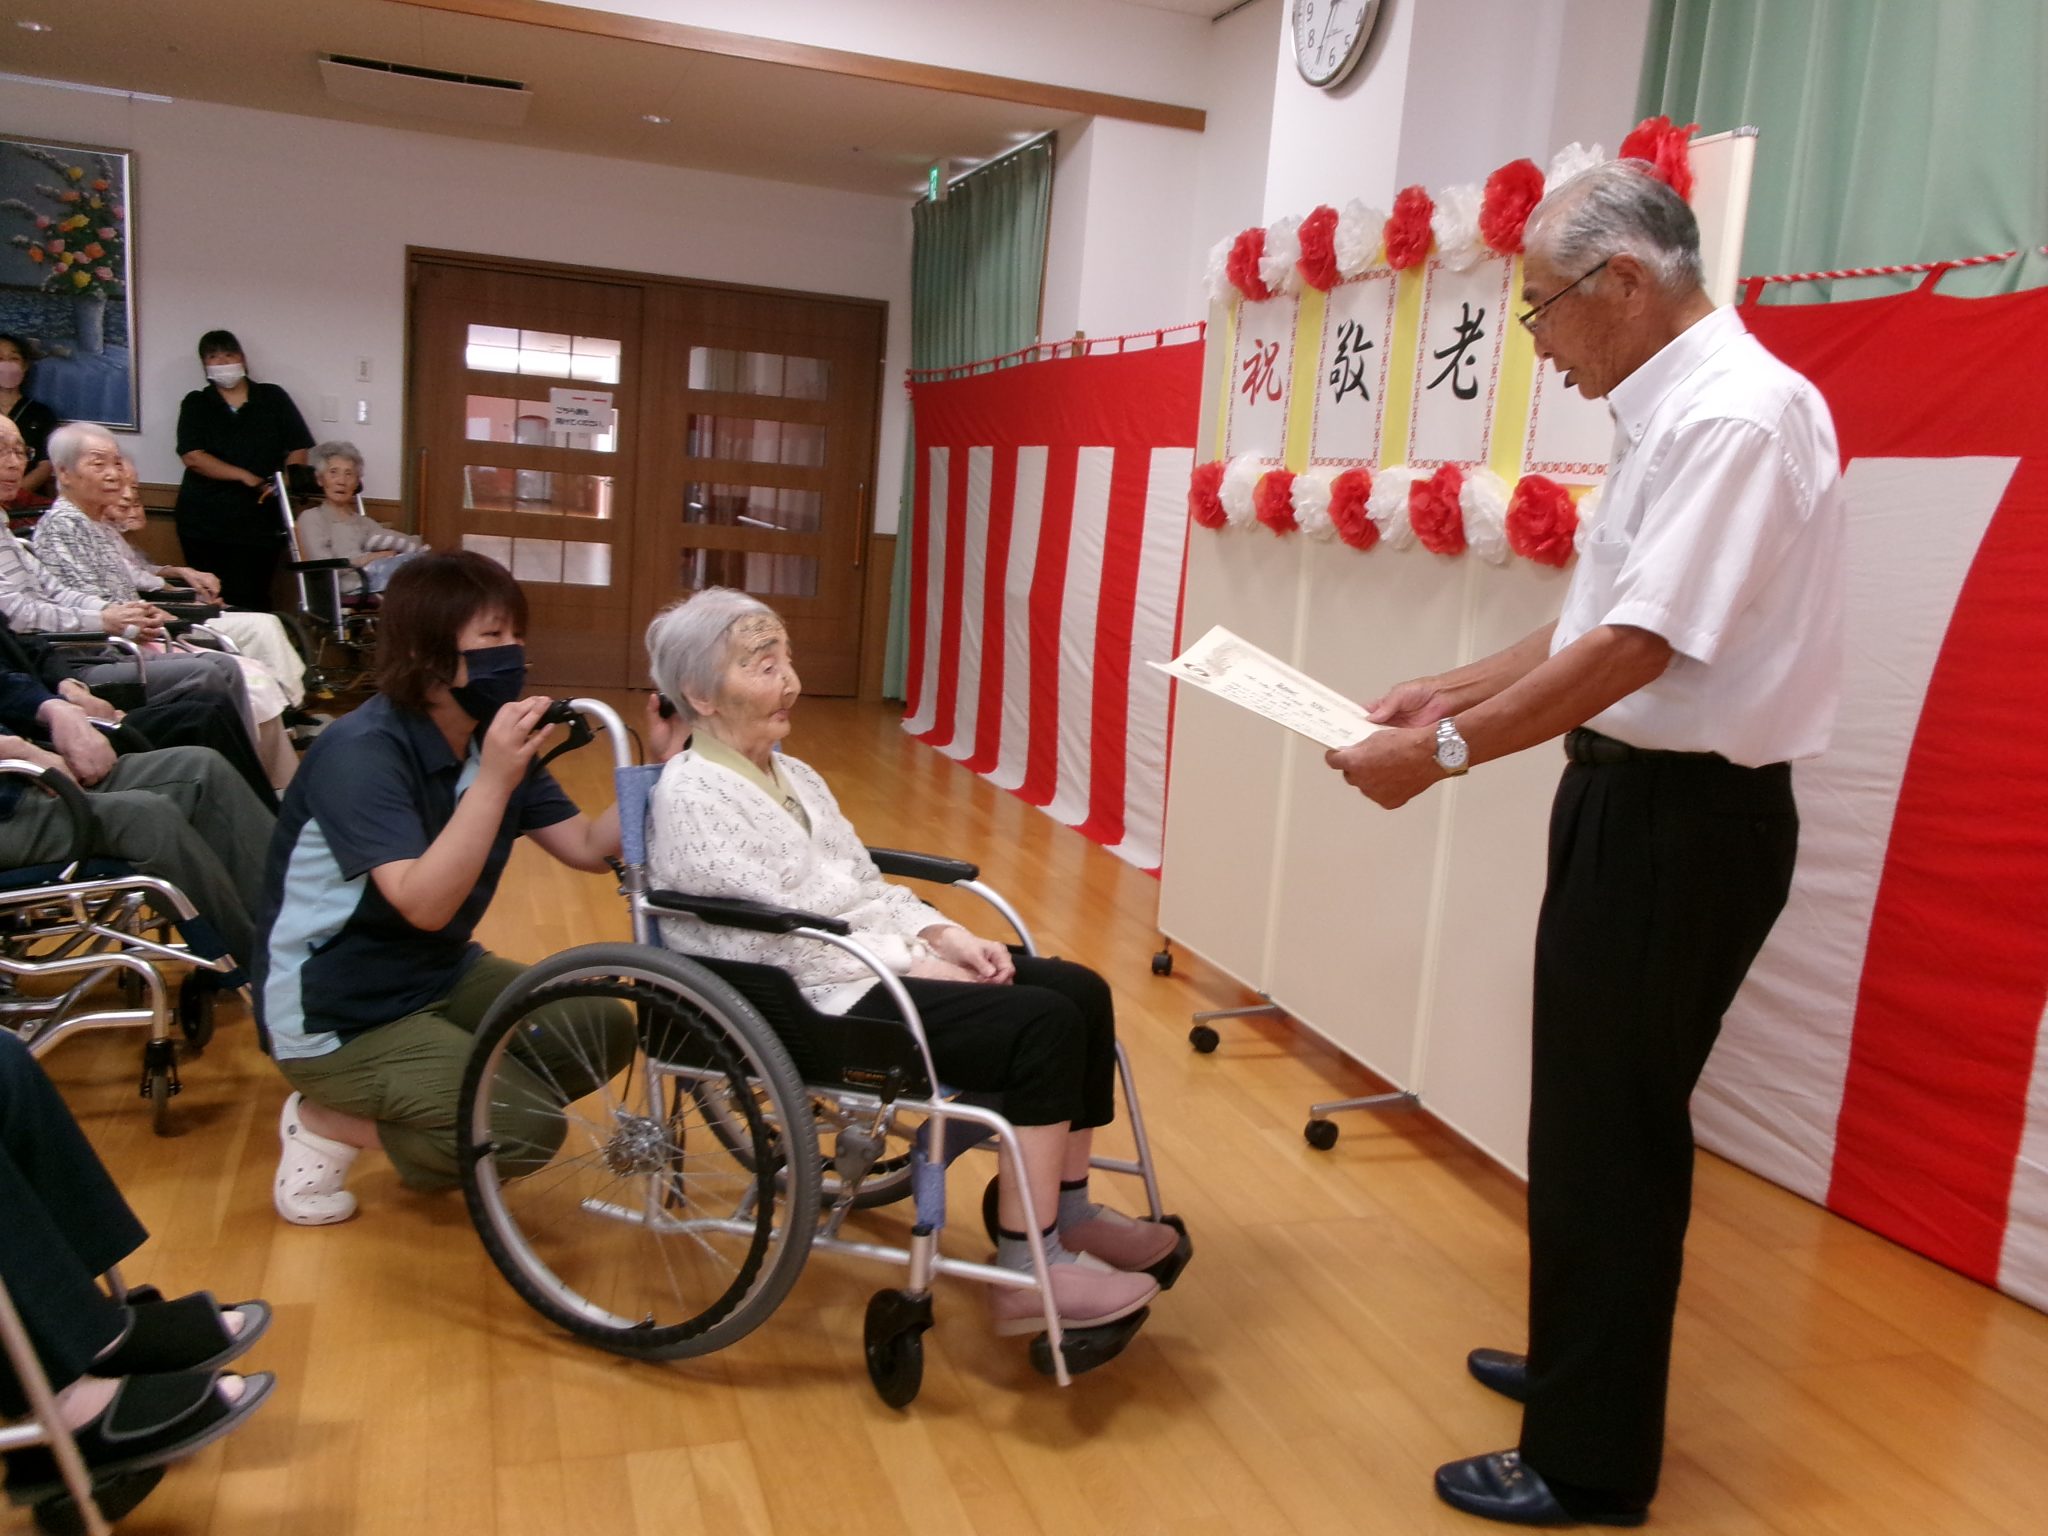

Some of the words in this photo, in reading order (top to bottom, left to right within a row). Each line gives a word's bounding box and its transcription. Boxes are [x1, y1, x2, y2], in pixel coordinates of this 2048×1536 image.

[1308, 29, 1315, 48] 8
[1328, 47, 1335, 67] 6
[1242, 339, 1283, 405] 祝
[1329, 319, 1374, 404] 敬
[1427, 302, 1485, 400] 老
